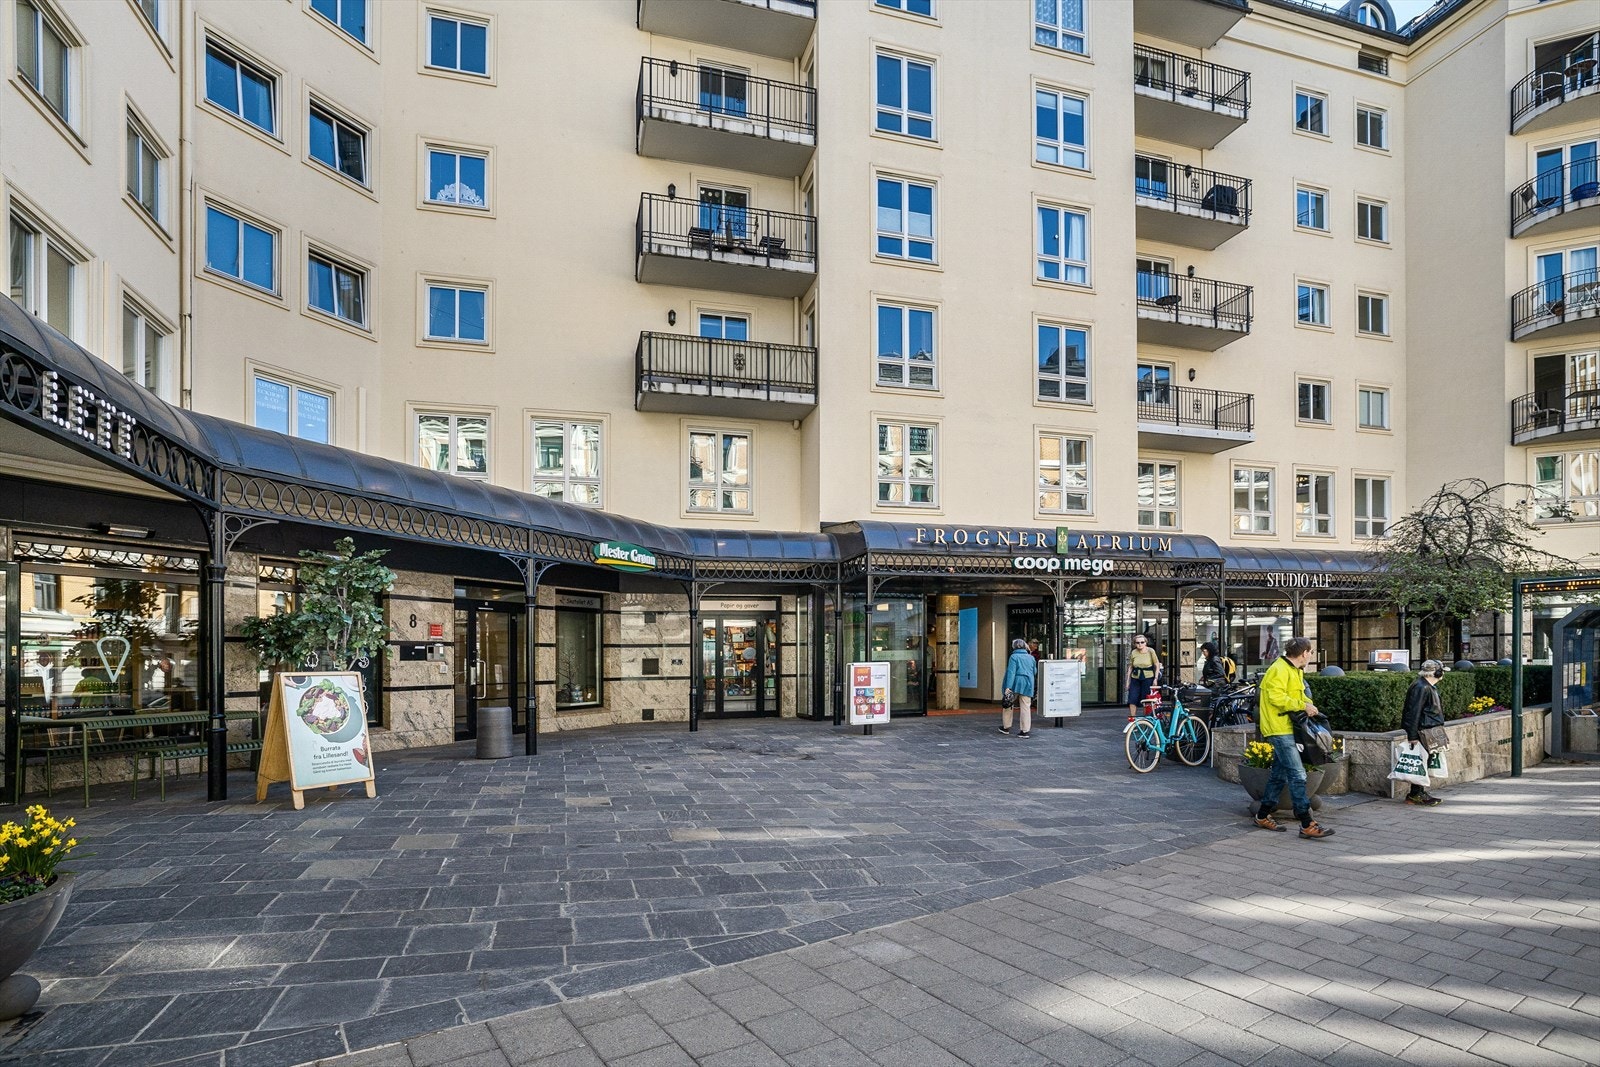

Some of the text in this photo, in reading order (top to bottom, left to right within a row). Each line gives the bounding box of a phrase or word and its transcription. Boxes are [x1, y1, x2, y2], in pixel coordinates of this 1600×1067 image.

[43, 371, 136, 458] LETT
[915, 527, 1173, 552] FROGNER ATRIUM
[599, 542, 656, 566] Mester Grønn
[1013, 556, 1114, 576] coop mega
[1266, 572, 1333, 588] STUDIO ALF
[720, 601, 735, 609] Papir
[409, 614, 417, 628] 8
[1399, 756, 1423, 767] coop
